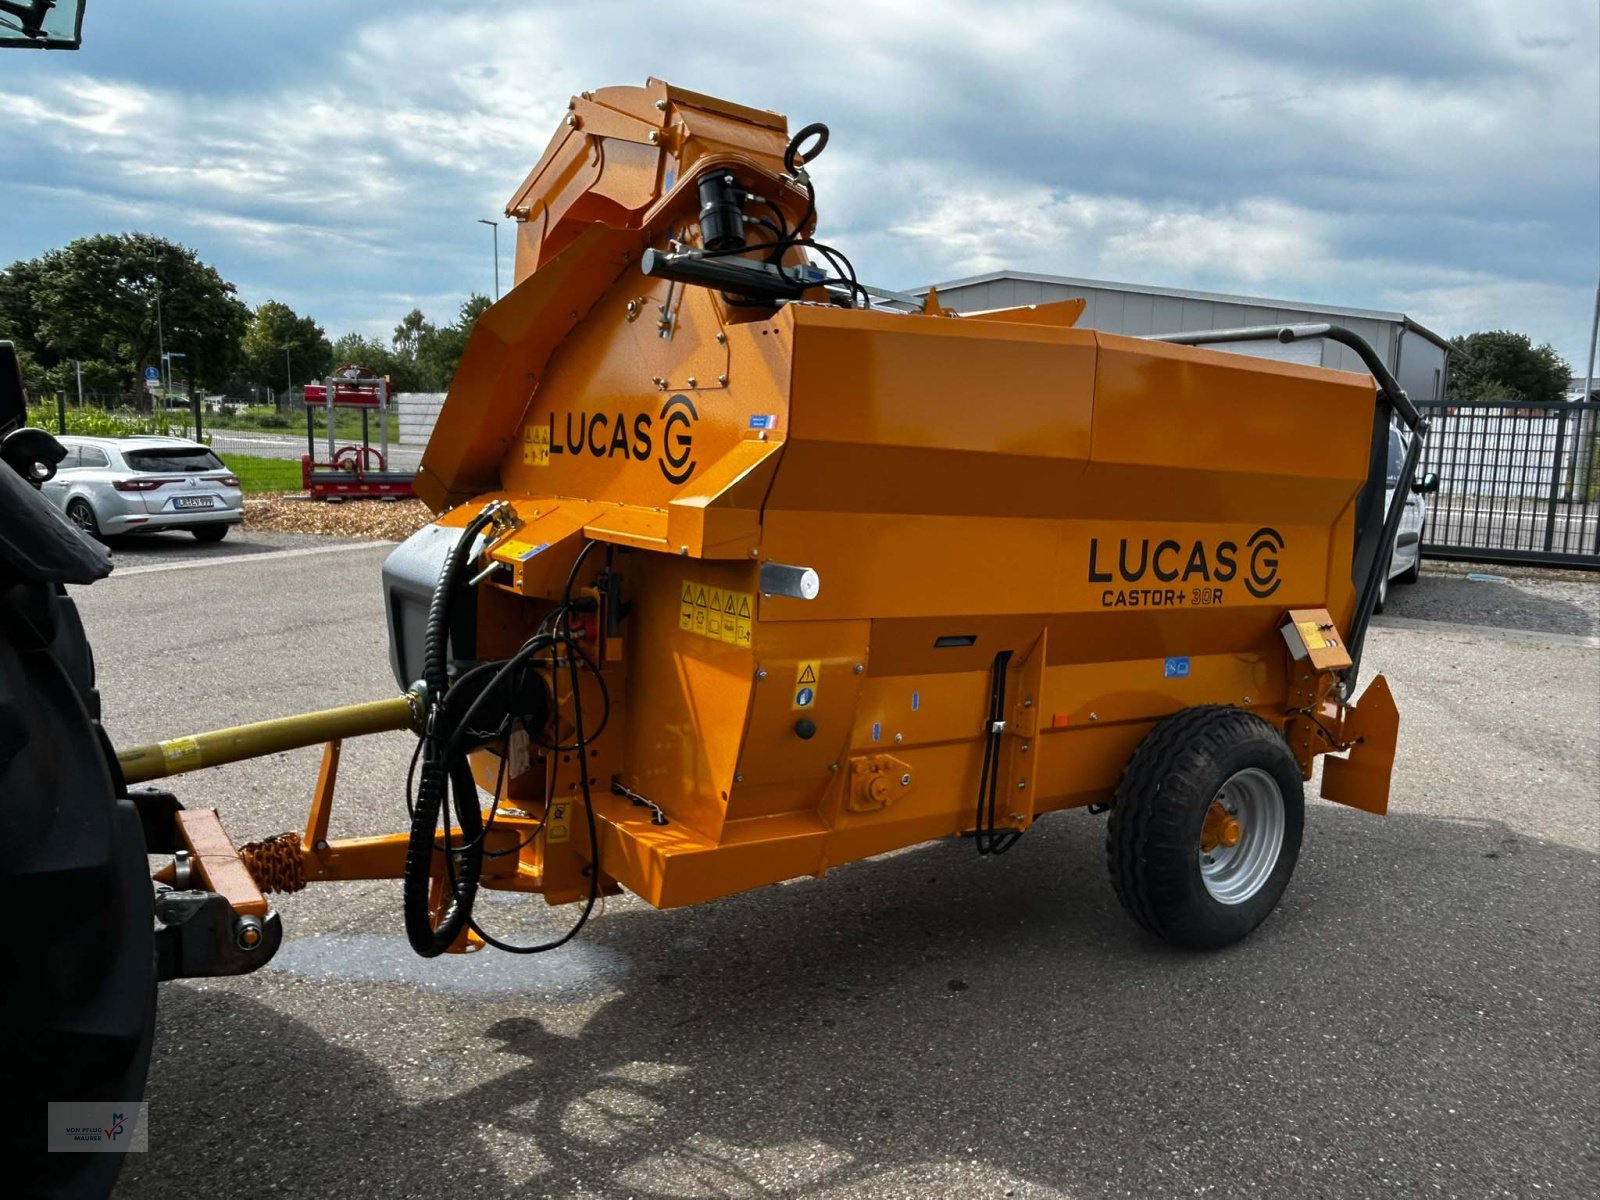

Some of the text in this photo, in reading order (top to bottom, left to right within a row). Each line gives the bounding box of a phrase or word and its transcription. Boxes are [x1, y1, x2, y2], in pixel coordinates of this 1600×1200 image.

[549, 411, 653, 462] LUCAS
[1088, 538, 1239, 583] LUCAS
[1102, 588, 1223, 607] CASTOR+ 30R
